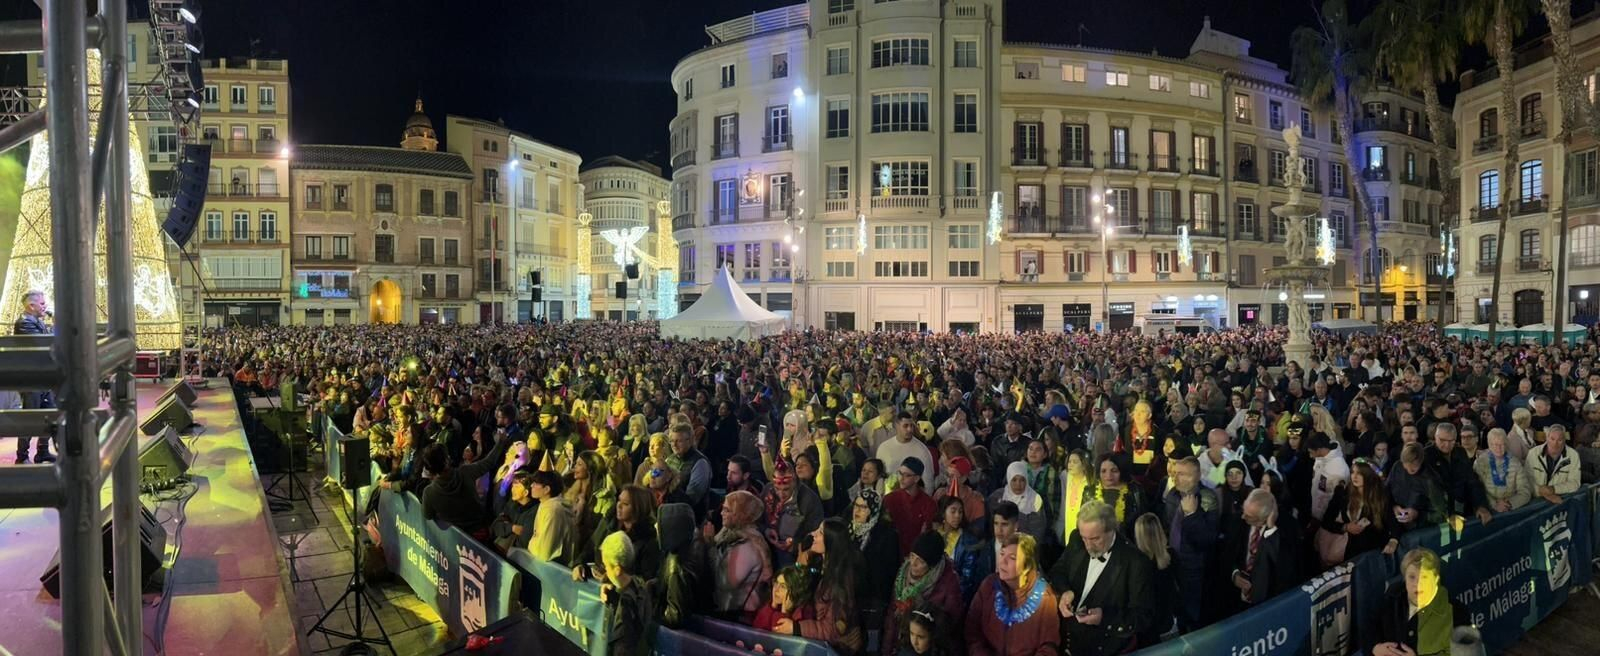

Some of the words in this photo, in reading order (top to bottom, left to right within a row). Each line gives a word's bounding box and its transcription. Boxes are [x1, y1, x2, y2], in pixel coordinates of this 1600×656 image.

[396, 514, 449, 571] Ayuntamiento
[407, 546, 418, 566] de
[419, 554, 450, 598] Málaga
[549, 597, 588, 645] Ayu
[1489, 579, 1536, 621] Málaga
